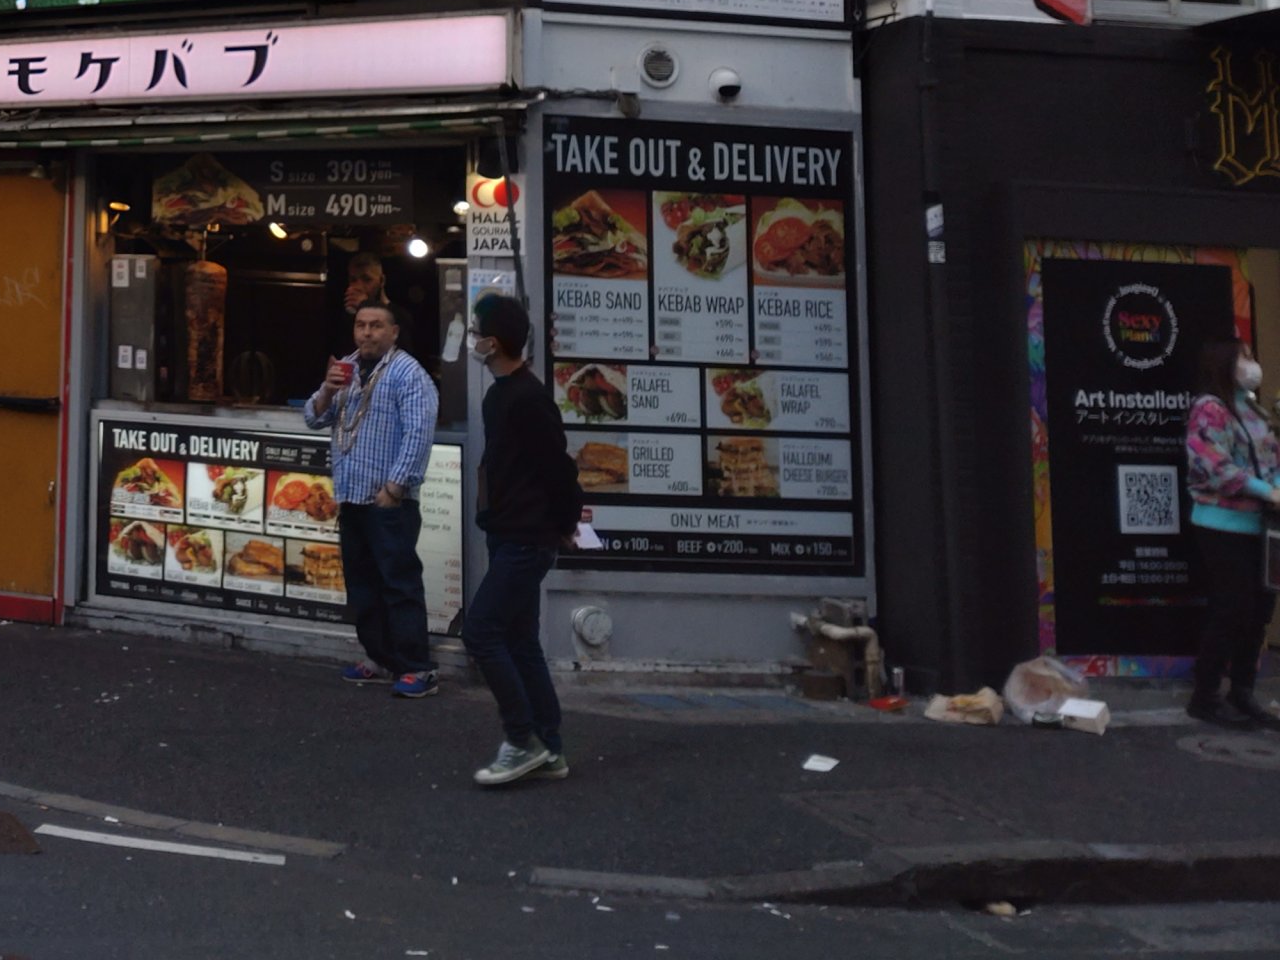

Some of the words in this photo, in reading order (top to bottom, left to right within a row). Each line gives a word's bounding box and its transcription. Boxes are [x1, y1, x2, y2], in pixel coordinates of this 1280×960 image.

[551, 133, 619, 175] TAKE
[629, 137, 682, 178] OUT
[687, 147, 706, 182] &
[713, 141, 842, 187] DELIVERY
[270, 160, 284, 182] S
[287, 171, 316, 183] size
[326, 159, 367, 183] 390
[267, 193, 286, 216] M
[288, 202, 316, 217] size
[324, 193, 367, 217] 490
[557, 289, 601, 309] KEBAB
[606, 291, 642, 311] SAND
[658, 293, 702, 313] KEBAB
[705, 296, 744, 315] WRAP
[758, 298, 801, 317] KEBAB
[805, 300, 833, 320] RICE
[632, 377, 673, 394] FALAFEL
[781, 382, 821, 399] FALAFEL
[632, 394, 660, 410] SAND
[781, 400, 811, 416] WRAP
[1074, 388, 1106, 409] Art
[1109, 389, 1196, 411] Installati
[112, 428, 147, 451] TAKE
[150, 431, 179, 454] OUT
[179, 442, 188, 456] &
[189, 435, 260, 462] DELIVERY
[632, 446, 674, 462] GRILLED
[782, 450, 833, 466] HALLOUMI
[632, 463, 671, 479] CHEESE
[783, 468, 813, 483] CHEESE
[815, 470, 849, 485] BURGER
[671, 513, 701, 528] ONLY
[708, 514, 741, 529] MEAT
[624, 537, 650, 552] ¥100
[677, 540, 703, 554] BEEF
[717, 540, 744, 555] ¥200
[770, 542, 790, 556] MIX
